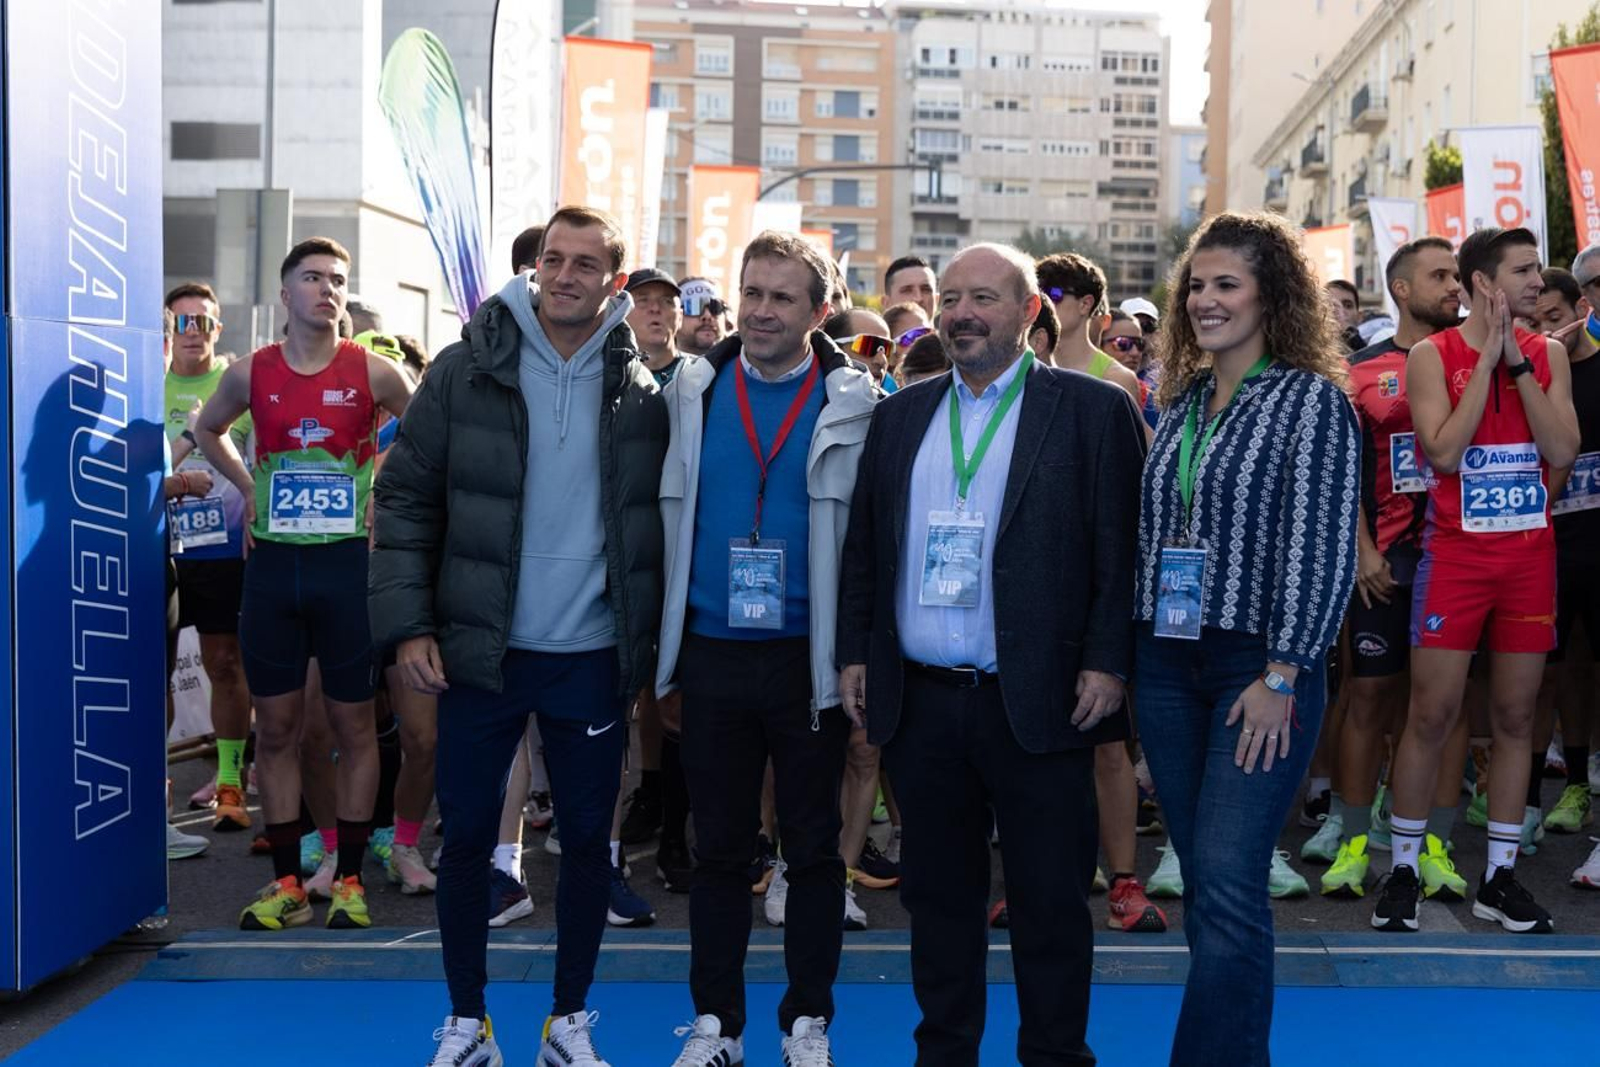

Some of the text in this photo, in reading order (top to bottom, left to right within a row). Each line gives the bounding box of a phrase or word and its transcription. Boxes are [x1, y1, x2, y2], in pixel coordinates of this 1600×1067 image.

[66, 0, 133, 841] DEJAHUELLA
[1397, 449, 1418, 471] 2
[1488, 451, 1537, 464] Avanza
[276, 488, 349, 510] 2453
[1470, 485, 1538, 510] 2361
[938, 580, 962, 596] VIP
[743, 603, 766, 619] VIP
[1167, 608, 1187, 625] VIP
